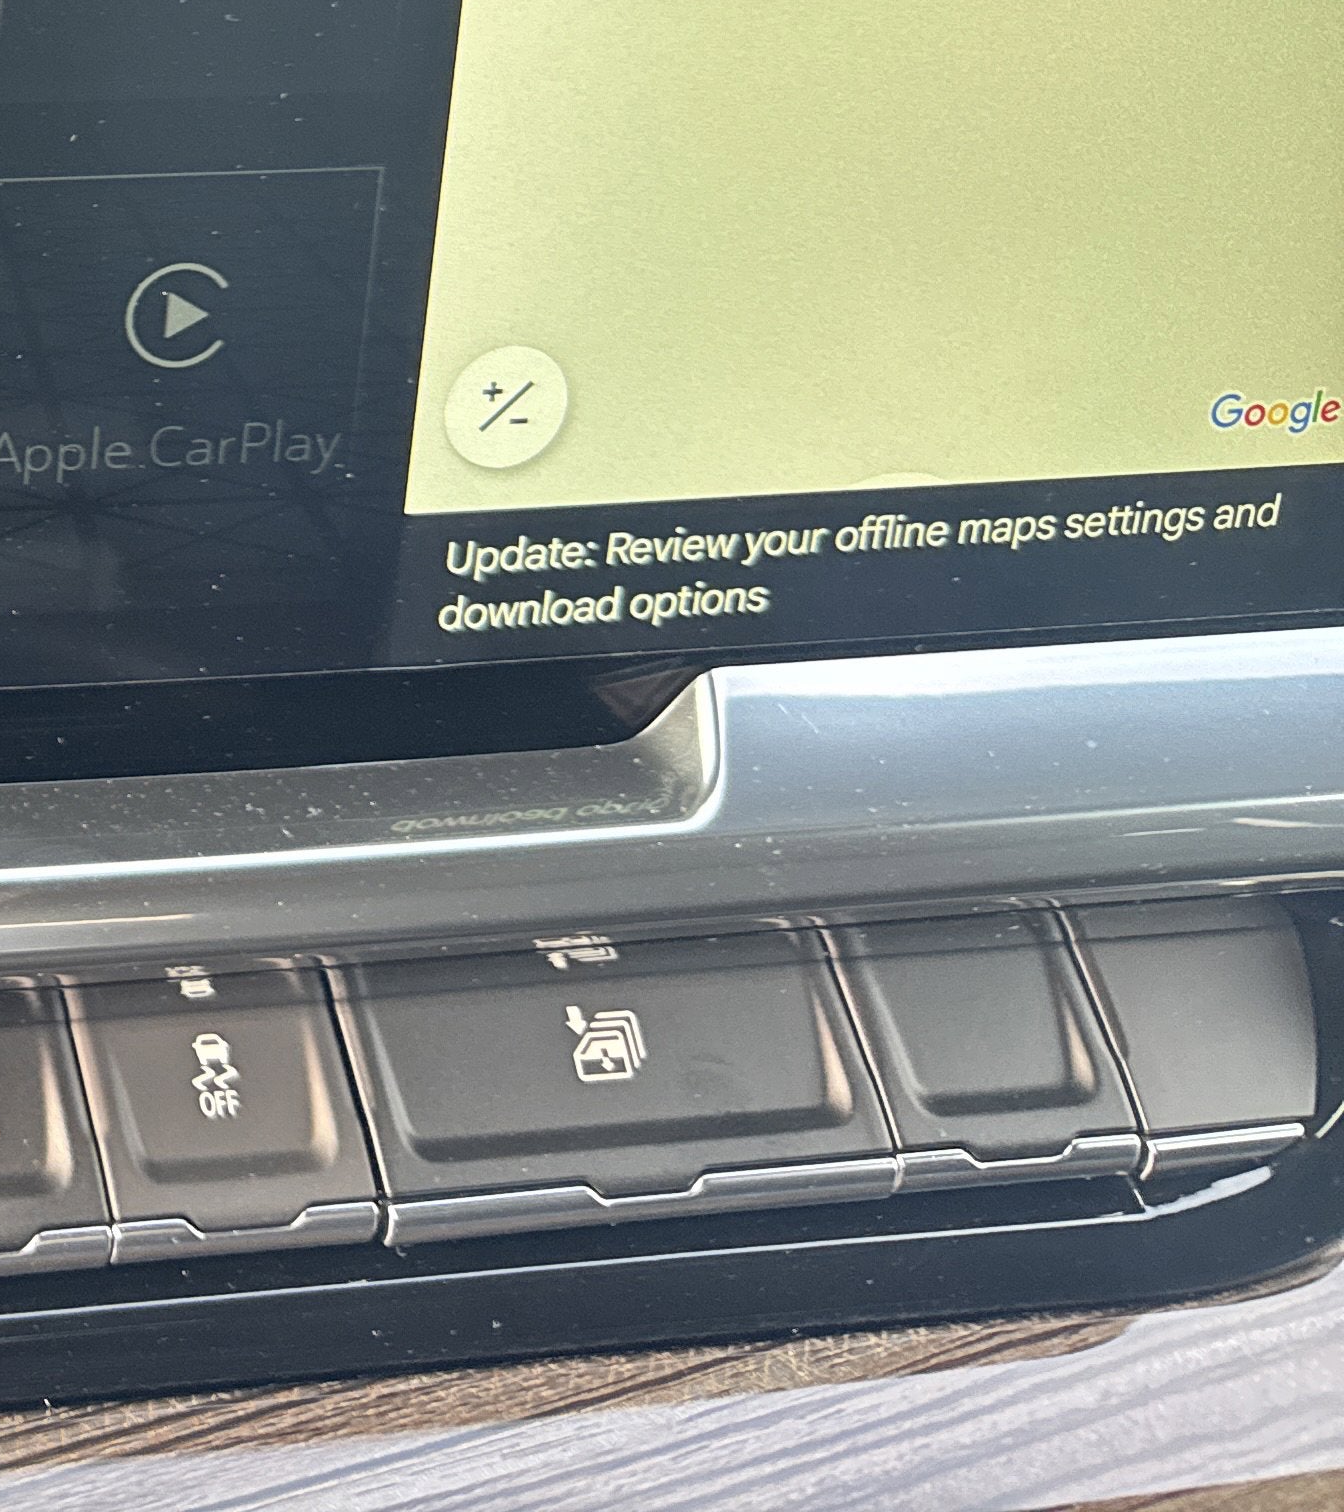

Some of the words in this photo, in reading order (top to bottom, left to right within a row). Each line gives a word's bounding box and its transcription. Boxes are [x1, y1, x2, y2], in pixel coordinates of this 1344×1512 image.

[1211, 389, 1341, 433] Google
[151, 420, 340, 474] CarPlay
[447, 536, 598, 581] Update:
[606, 527, 739, 565] Review
[741, 528, 829, 565] your
[835, 515, 950, 551] offline
[958, 516, 1057, 549] maps
[1064, 501, 1205, 541] settings
[1214, 493, 1281, 529] and
[439, 586, 623, 631] download
[630, 581, 769, 626] options
[198, 1089, 241, 1119] OFF
